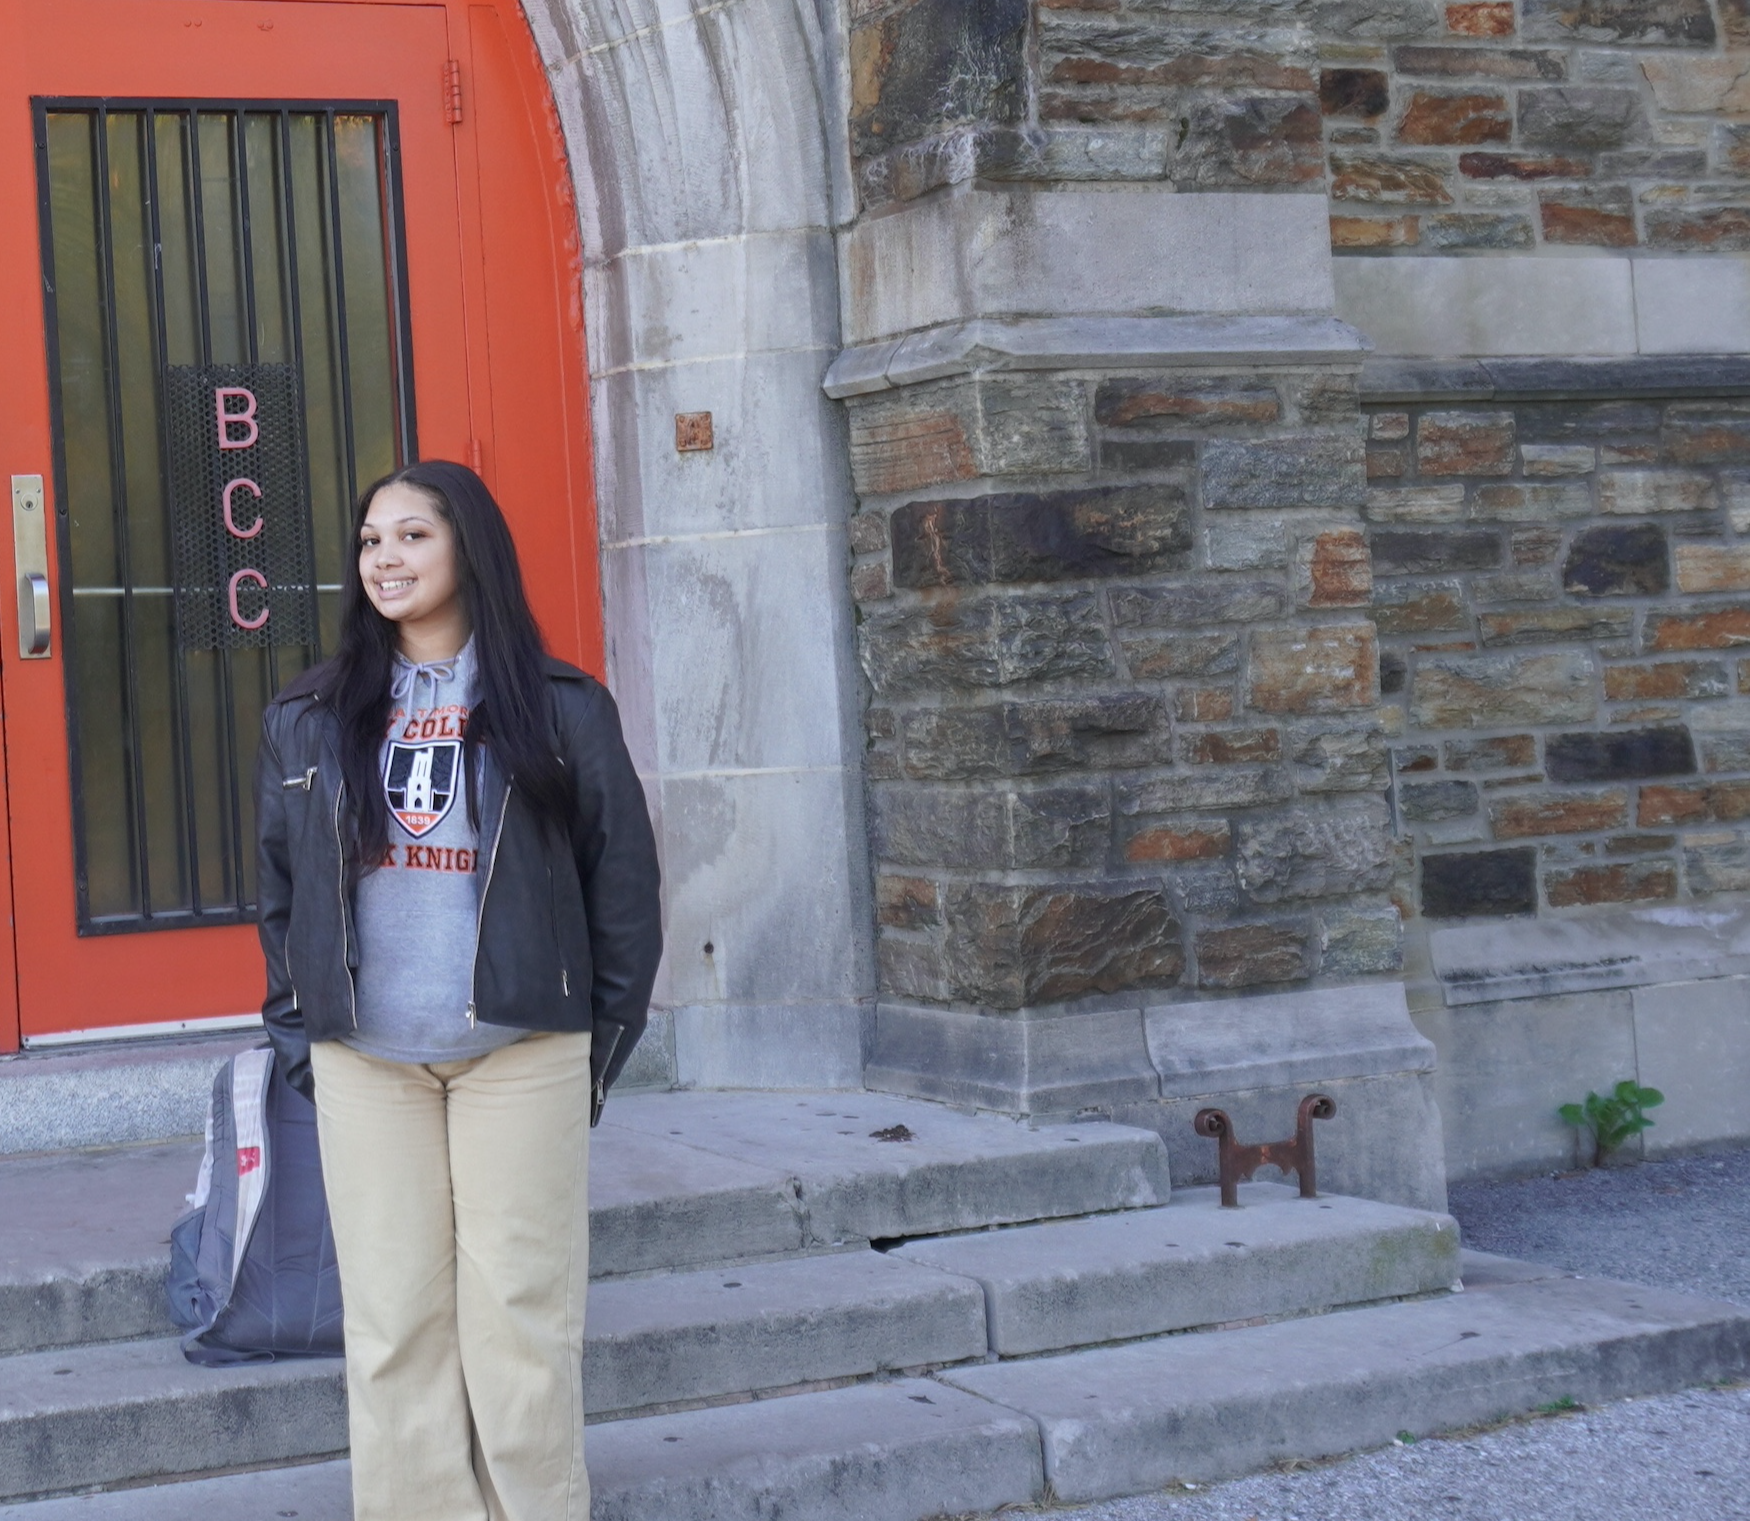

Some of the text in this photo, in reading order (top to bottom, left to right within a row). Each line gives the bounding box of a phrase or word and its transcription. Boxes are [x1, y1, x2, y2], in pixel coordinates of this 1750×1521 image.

[216, 386, 271, 631] BCC
[405, 815, 431, 825] 1839
[405, 844, 478, 875] KNIG
